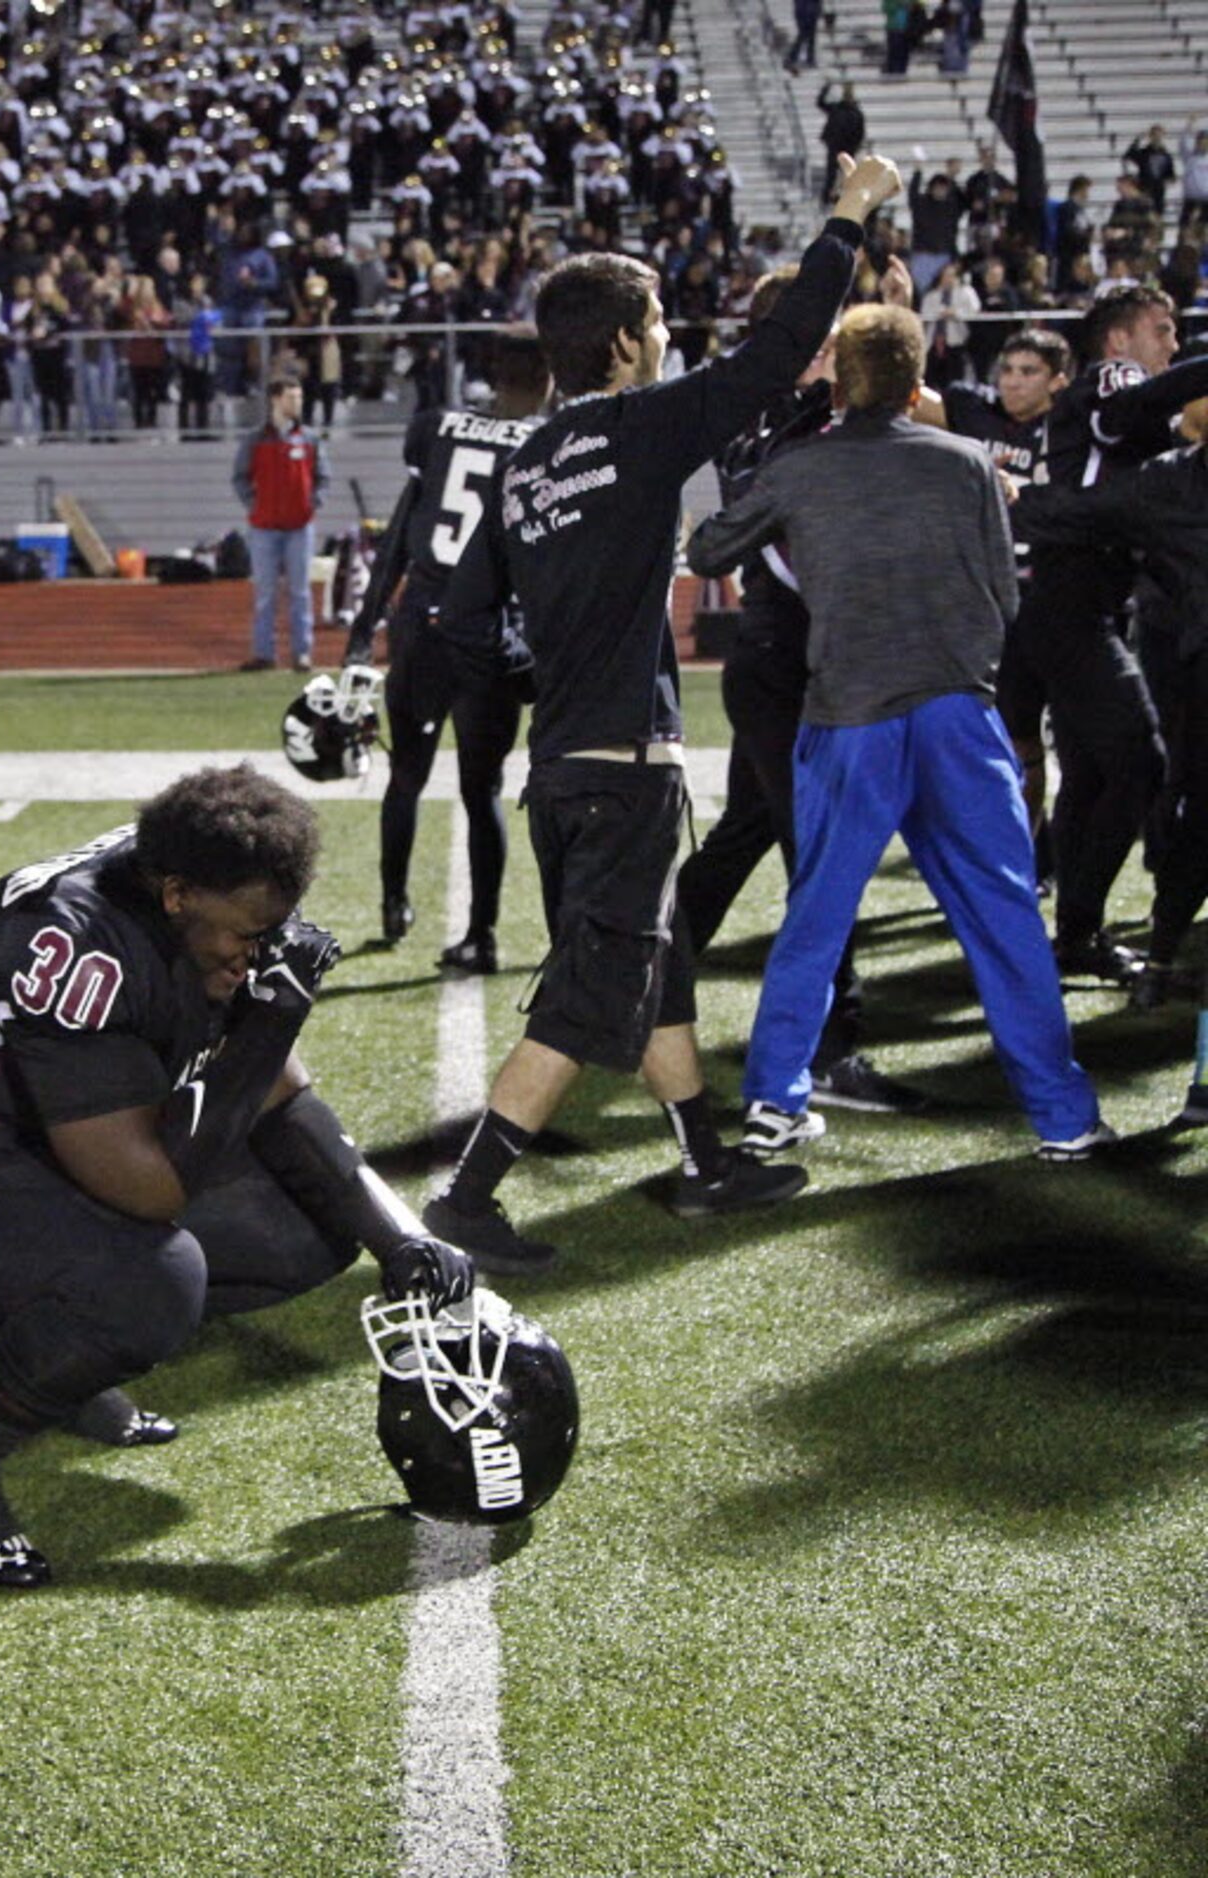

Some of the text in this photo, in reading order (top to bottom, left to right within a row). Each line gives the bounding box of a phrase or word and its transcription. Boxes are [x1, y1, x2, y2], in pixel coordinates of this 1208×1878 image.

[438, 411, 534, 449] PEGUES
[431, 446, 496, 567] 5
[11, 925, 123, 1031] 30
